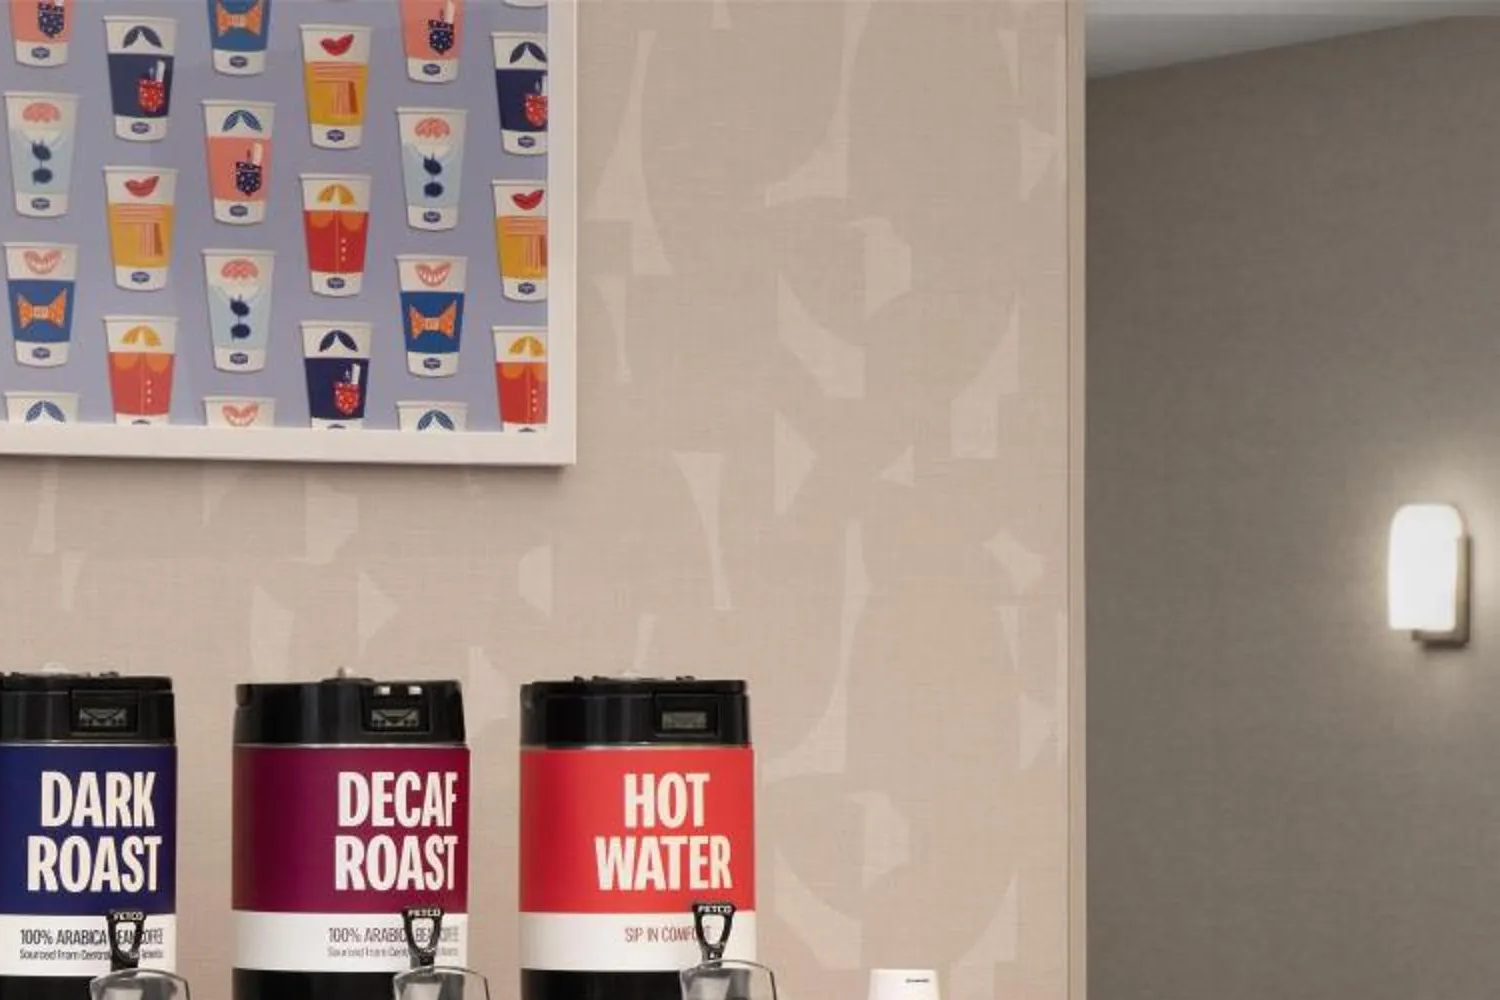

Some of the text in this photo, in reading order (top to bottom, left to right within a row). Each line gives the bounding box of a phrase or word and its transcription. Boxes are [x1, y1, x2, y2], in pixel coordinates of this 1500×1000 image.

[41, 771, 156, 828] DARK
[338, 771, 458, 828] DECAF
[624, 772, 710, 829] HOT
[27, 835, 162, 893] ROAST
[335, 835, 459, 891] ROAST
[594, 835, 733, 892] WATER
[20, 928, 53, 945] 100%
[56, 928, 107, 945] ARABICA
[328, 927, 362, 943] 100%
[364, 927, 409, 943] ARABIC
[625, 927, 644, 943] SIP
[647, 927, 658, 942] IN
